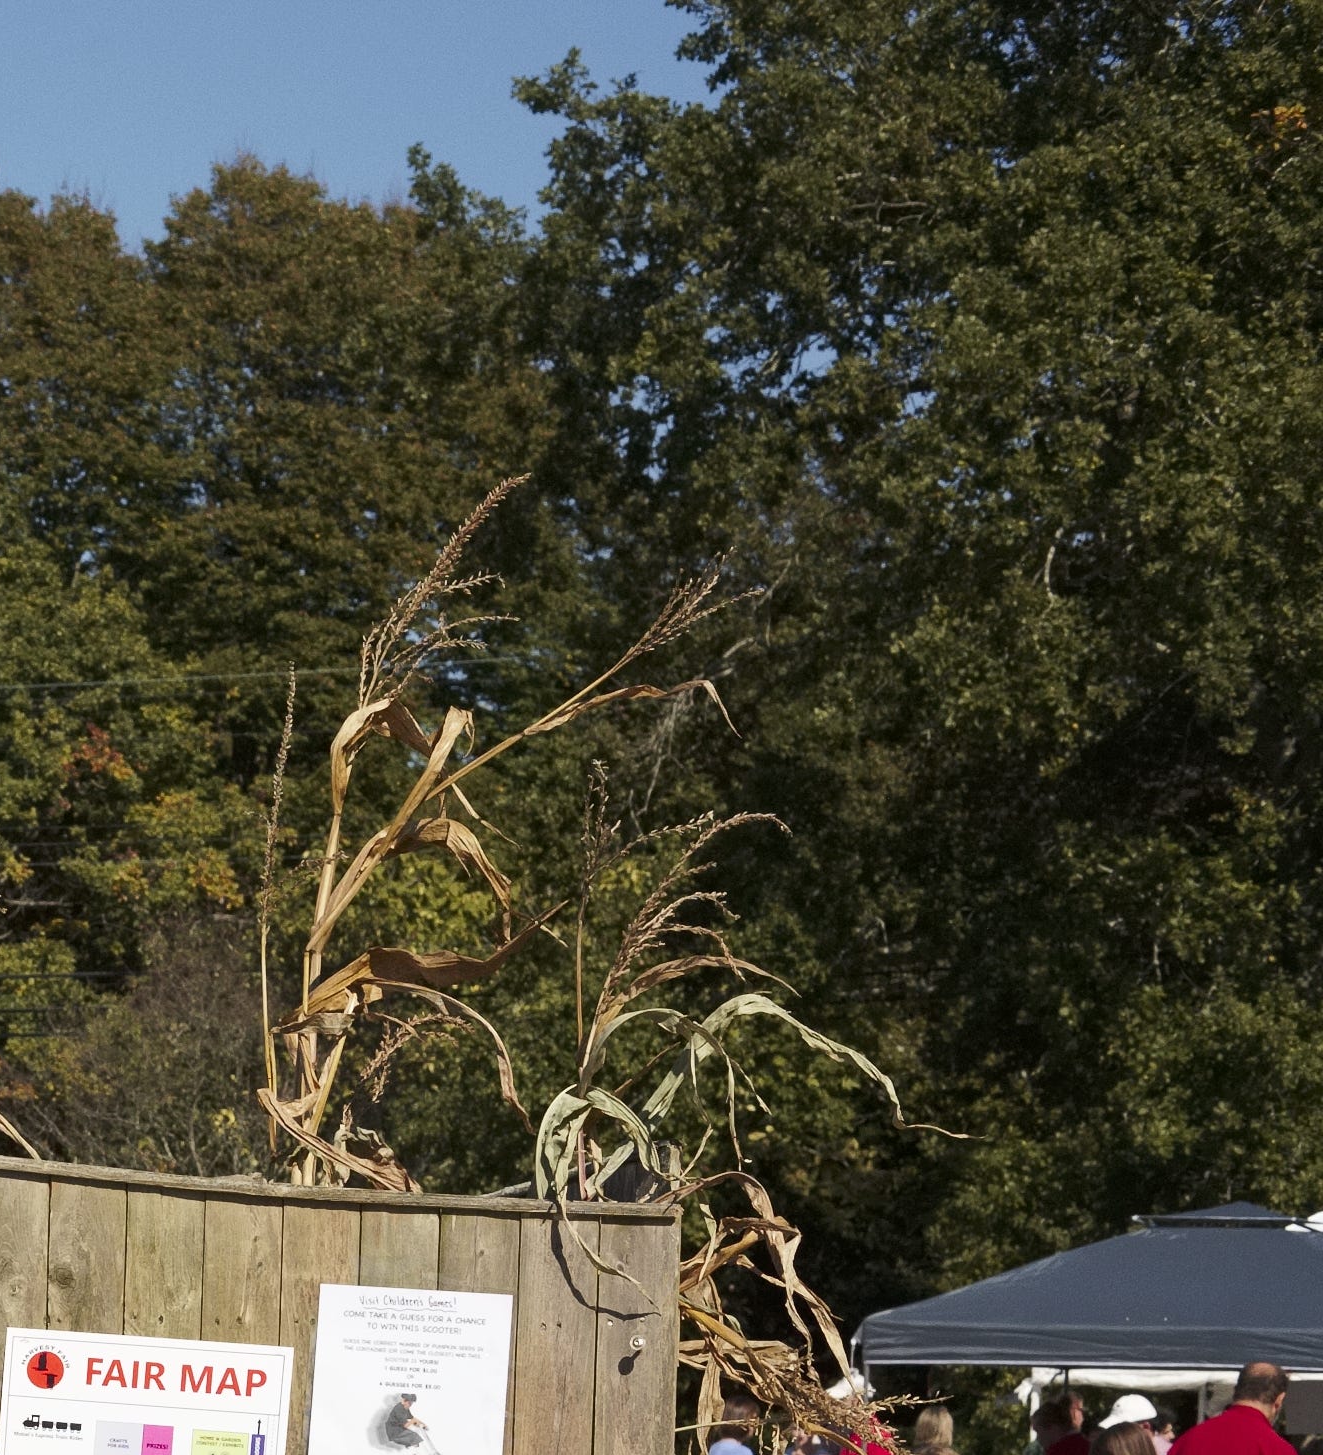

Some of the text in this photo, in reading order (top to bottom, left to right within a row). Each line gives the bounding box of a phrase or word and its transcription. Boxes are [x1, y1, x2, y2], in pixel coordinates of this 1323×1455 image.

[343, 1310, 365, 1318] COME
[369, 1311, 387, 1319] TAKE
[399, 1313, 425, 1321] GUESS
[455, 1317, 486, 1326] CHANCE
[367, 1322, 377, 1330] TO
[401, 1324, 419, 1332] THIS
[85, 1357, 267, 1398] FAIR MAP
